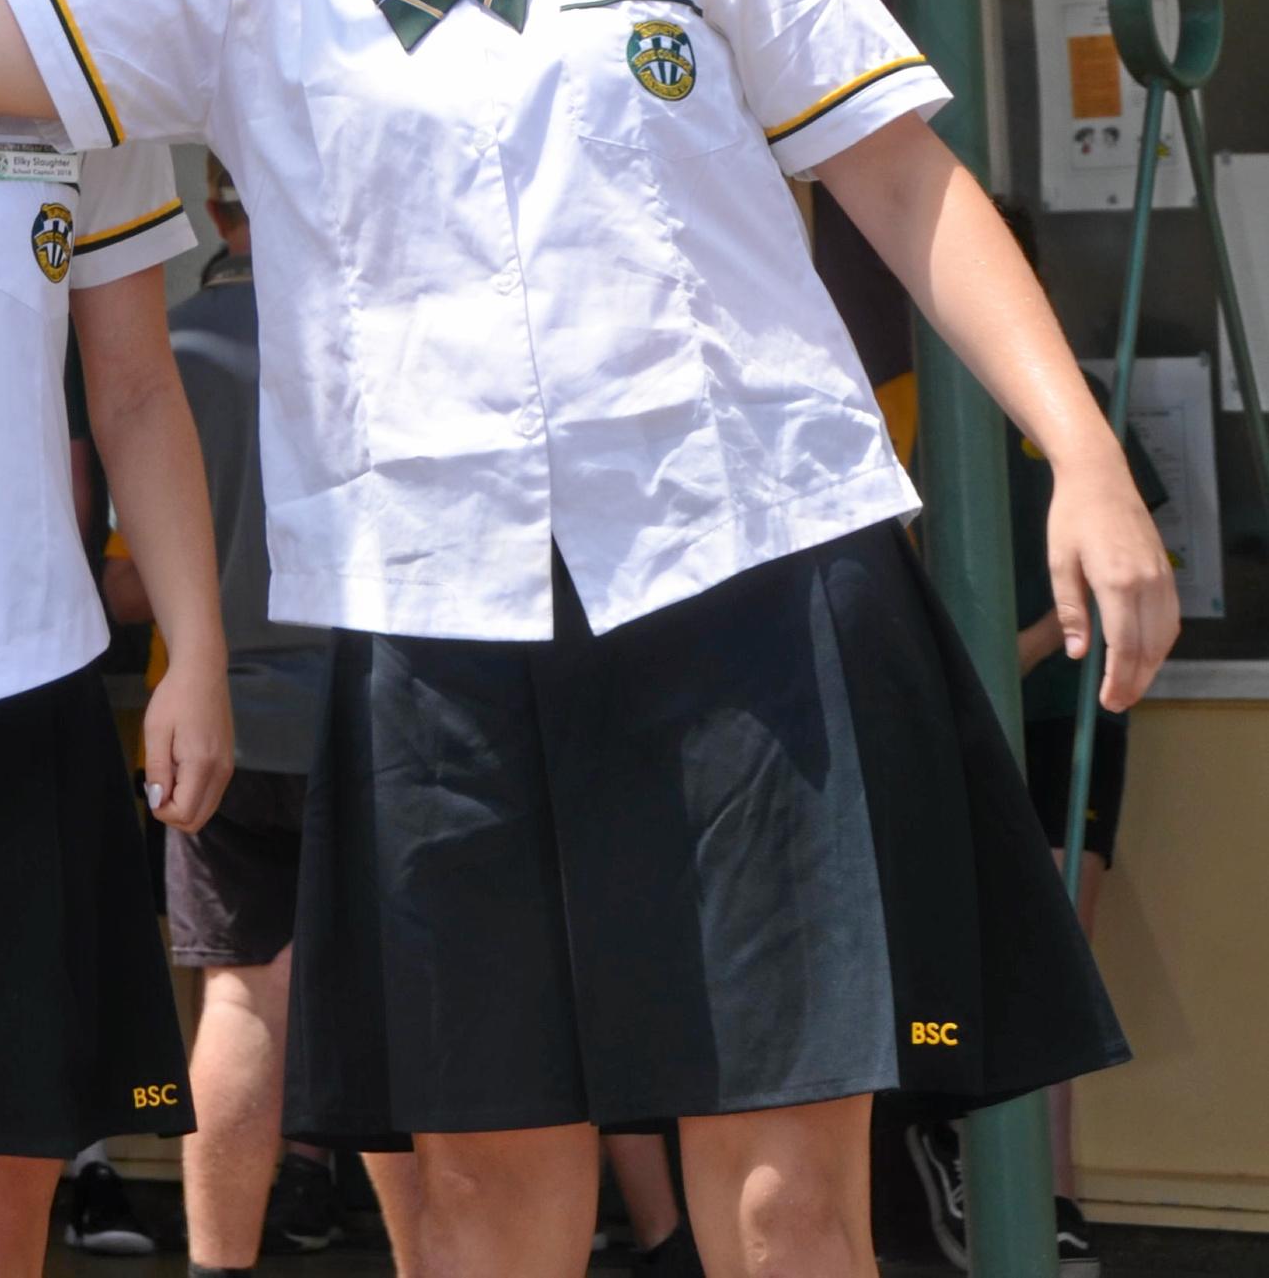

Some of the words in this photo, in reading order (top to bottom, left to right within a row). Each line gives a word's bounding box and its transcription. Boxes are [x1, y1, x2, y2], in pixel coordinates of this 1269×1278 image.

[32, 156, 70, 169] Slaughter
[911, 1021, 958, 1046] BSC
[133, 1083, 178, 1109] BSC
